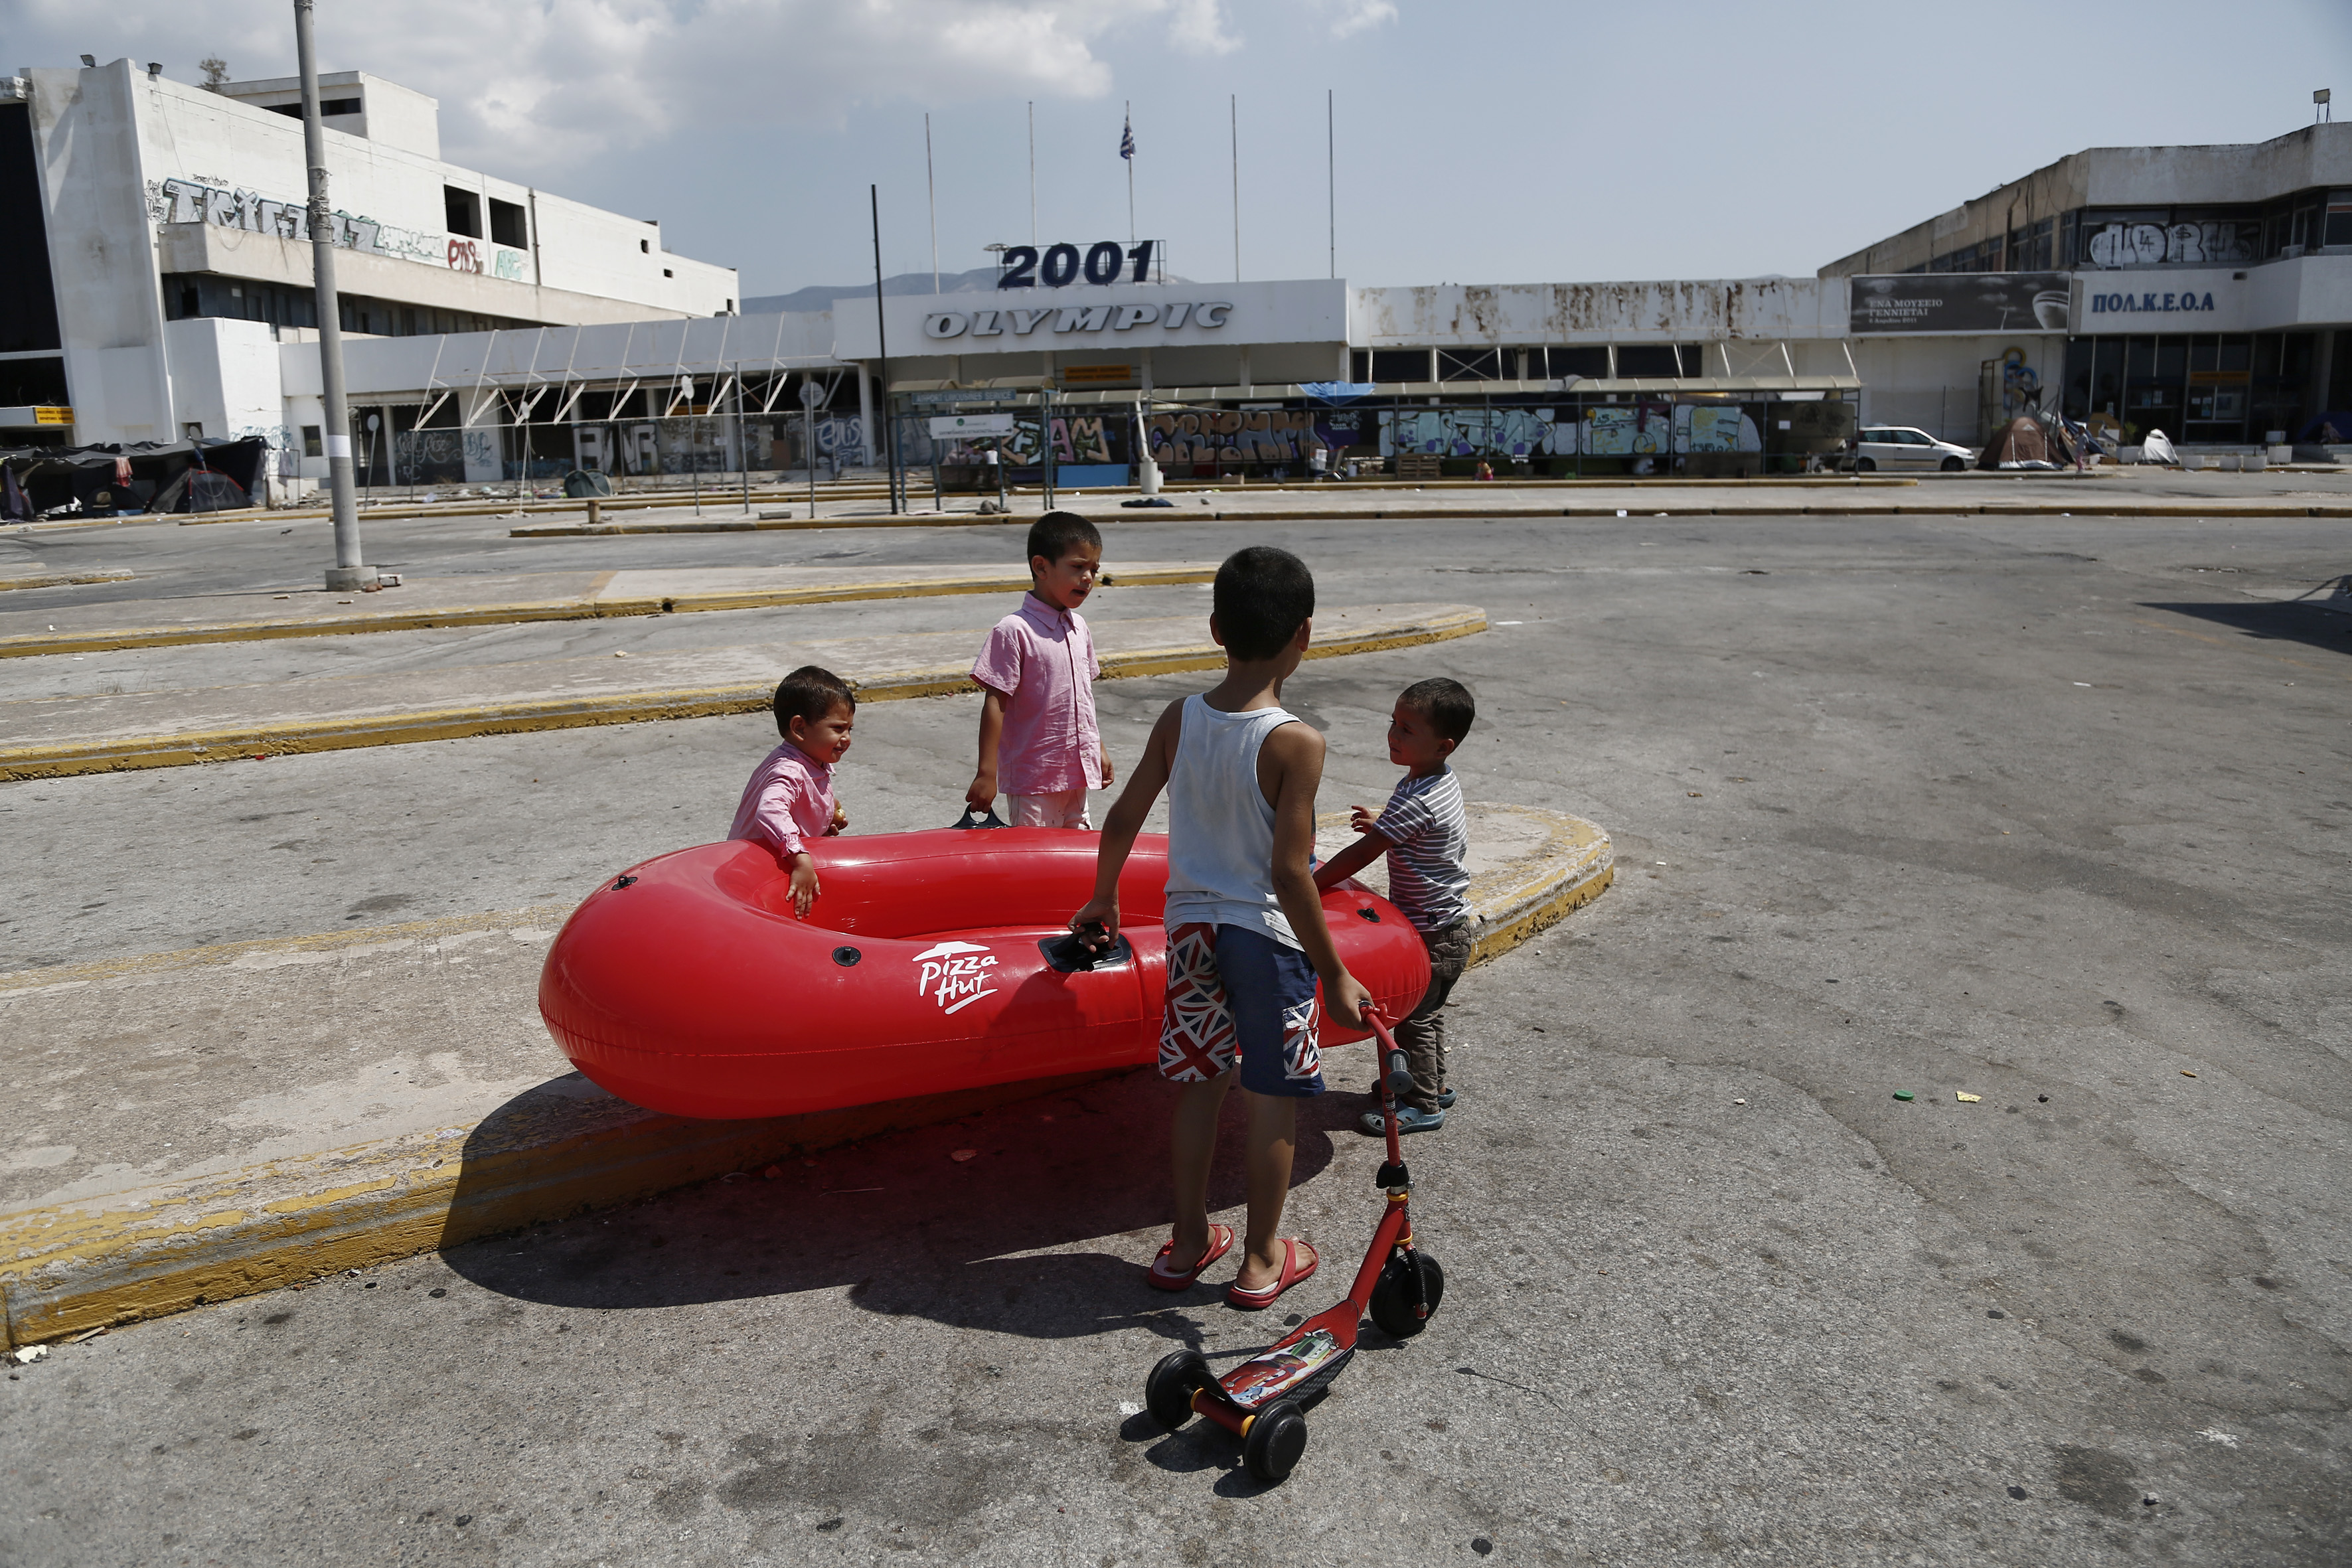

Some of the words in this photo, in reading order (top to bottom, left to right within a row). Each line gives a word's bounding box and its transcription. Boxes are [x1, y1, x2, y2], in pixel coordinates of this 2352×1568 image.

[998, 240, 1154, 289] 2001
[1869, 299, 1892, 308] ΕΝΑ
[1894, 299, 1943, 307] ΜΟΥΣΕΙΟ
[1869, 309, 1928, 317] ΓΕΝΝΙΕΤΑΙ
[2092, 293, 2215, 313] ΠΟΛ.Κ.Ε.Ο.Α
[925, 302, 1233, 338] OLYMPIC
[916, 393, 943, 402] AIRPORT
[945, 391, 982, 402] LIMOUSINES
[984, 390, 1012, 400] SERVICE
[919, 953, 999, 996] Pizza
[934, 971, 992, 1007] Hut
